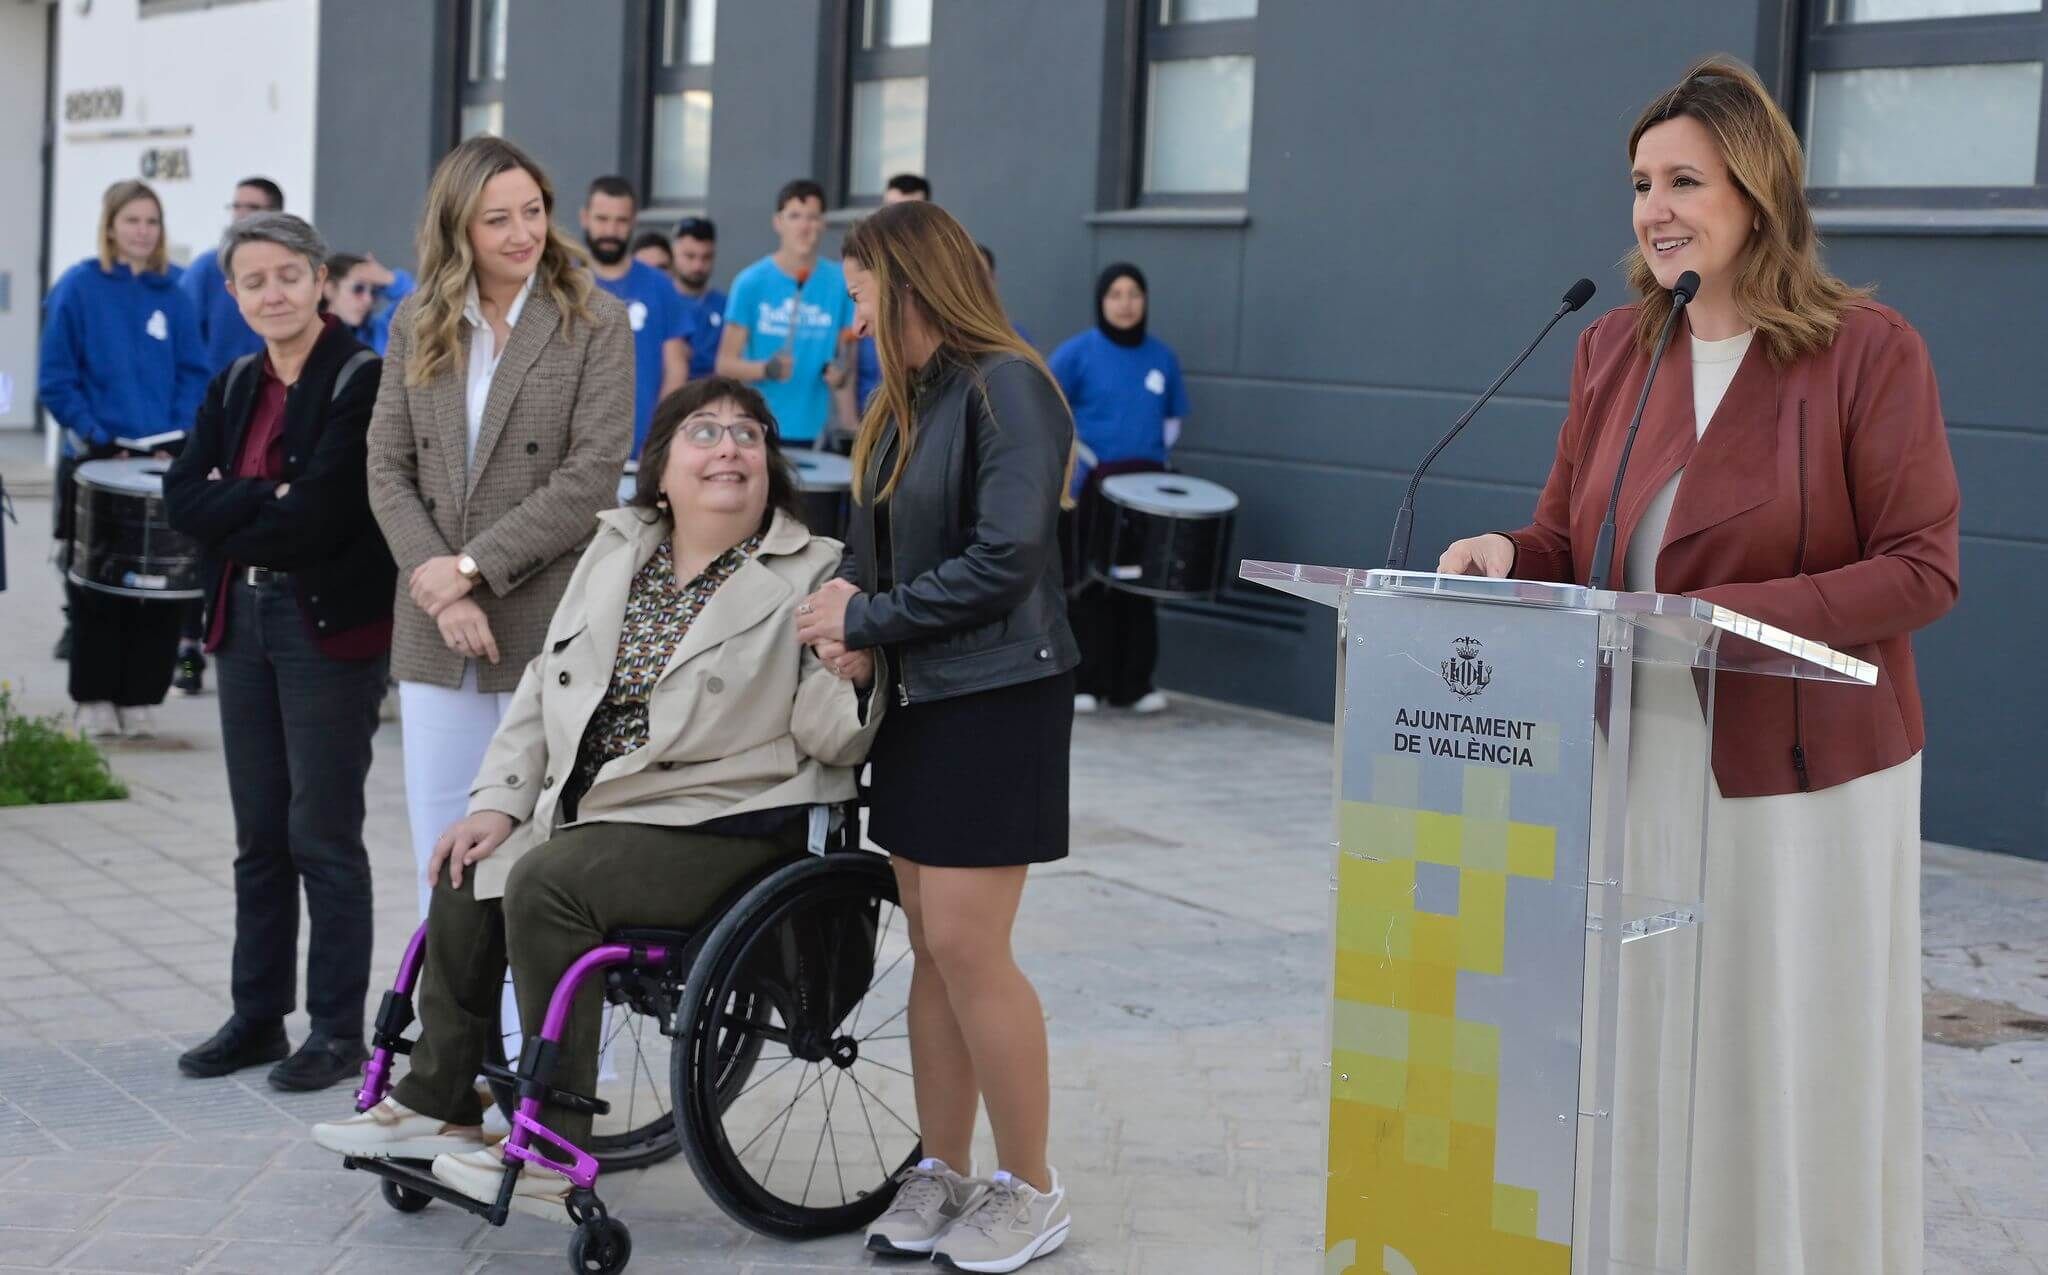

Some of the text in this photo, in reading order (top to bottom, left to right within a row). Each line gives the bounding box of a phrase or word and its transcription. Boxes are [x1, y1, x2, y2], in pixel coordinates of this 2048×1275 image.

[1395, 708, 1536, 741] AJUNTAMENT
[1394, 733, 1534, 767] DE VALÈNCIA
